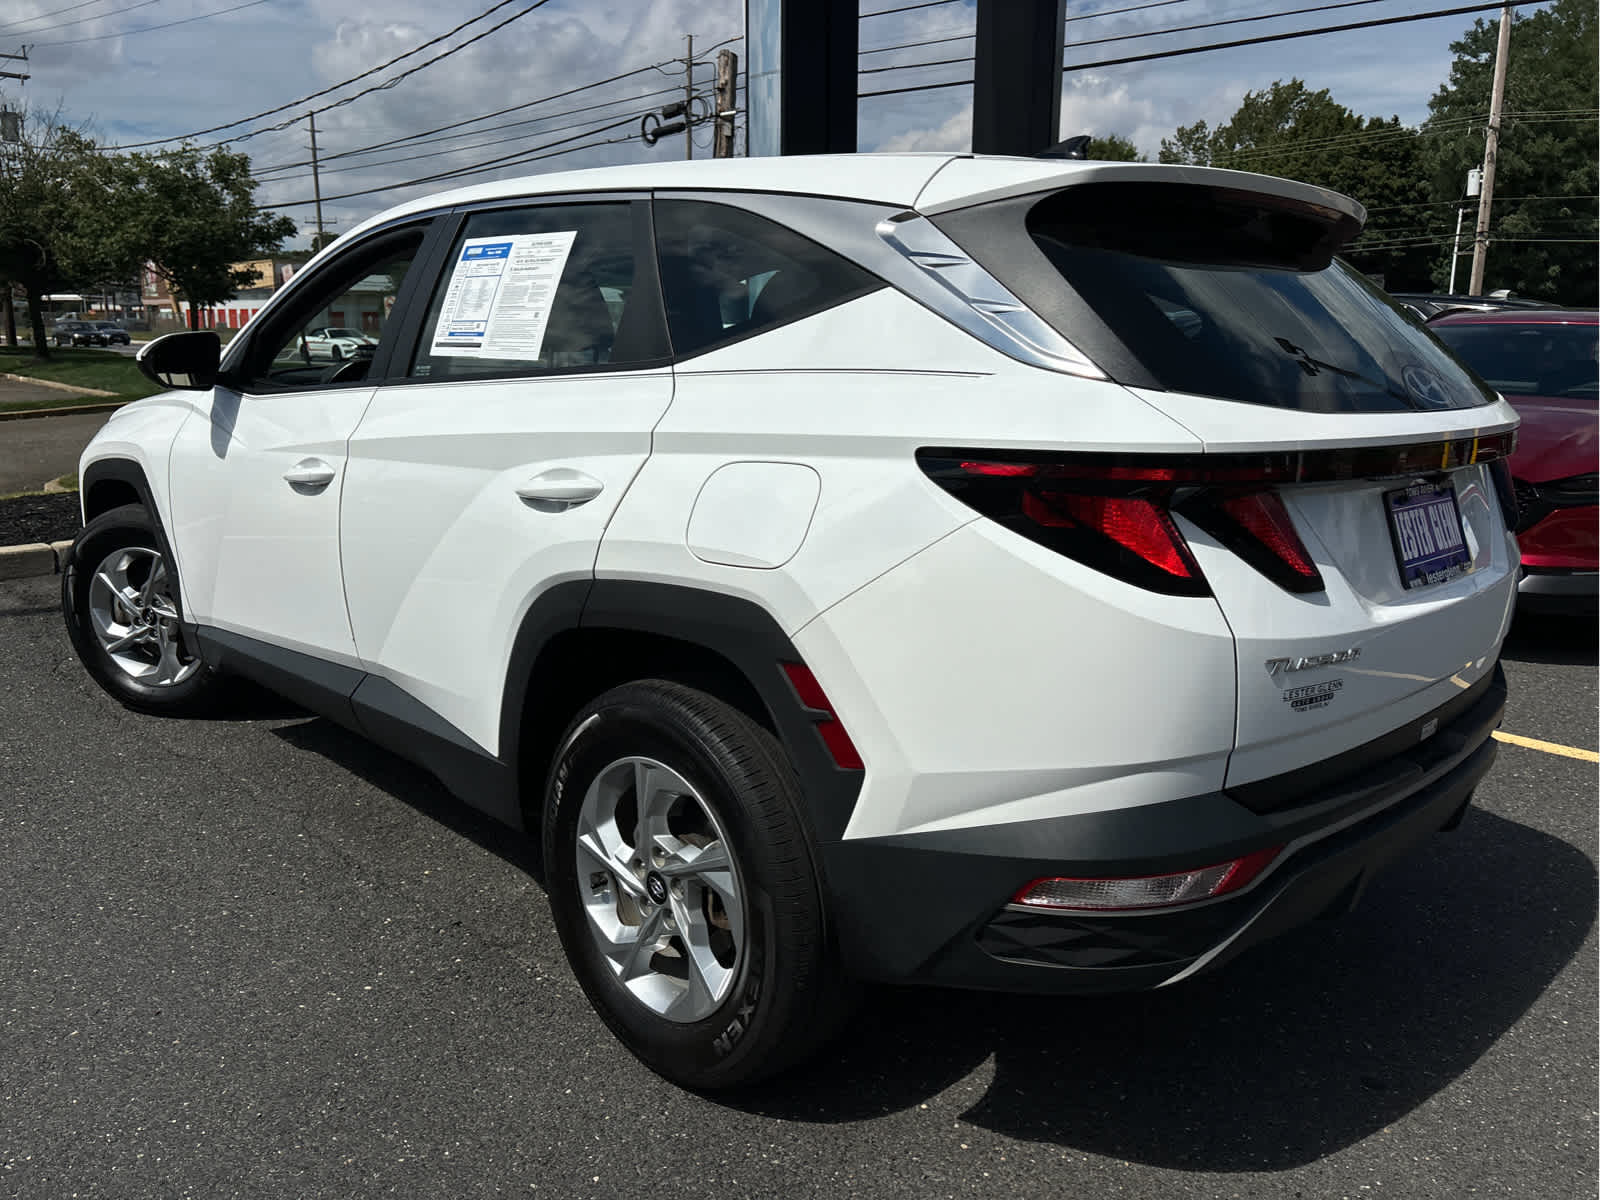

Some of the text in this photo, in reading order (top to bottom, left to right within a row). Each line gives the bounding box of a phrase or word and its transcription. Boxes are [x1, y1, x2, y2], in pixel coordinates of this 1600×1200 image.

[1394, 501, 1463, 561] LESTER GLENN
[1283, 685, 1317, 702] LESTER
